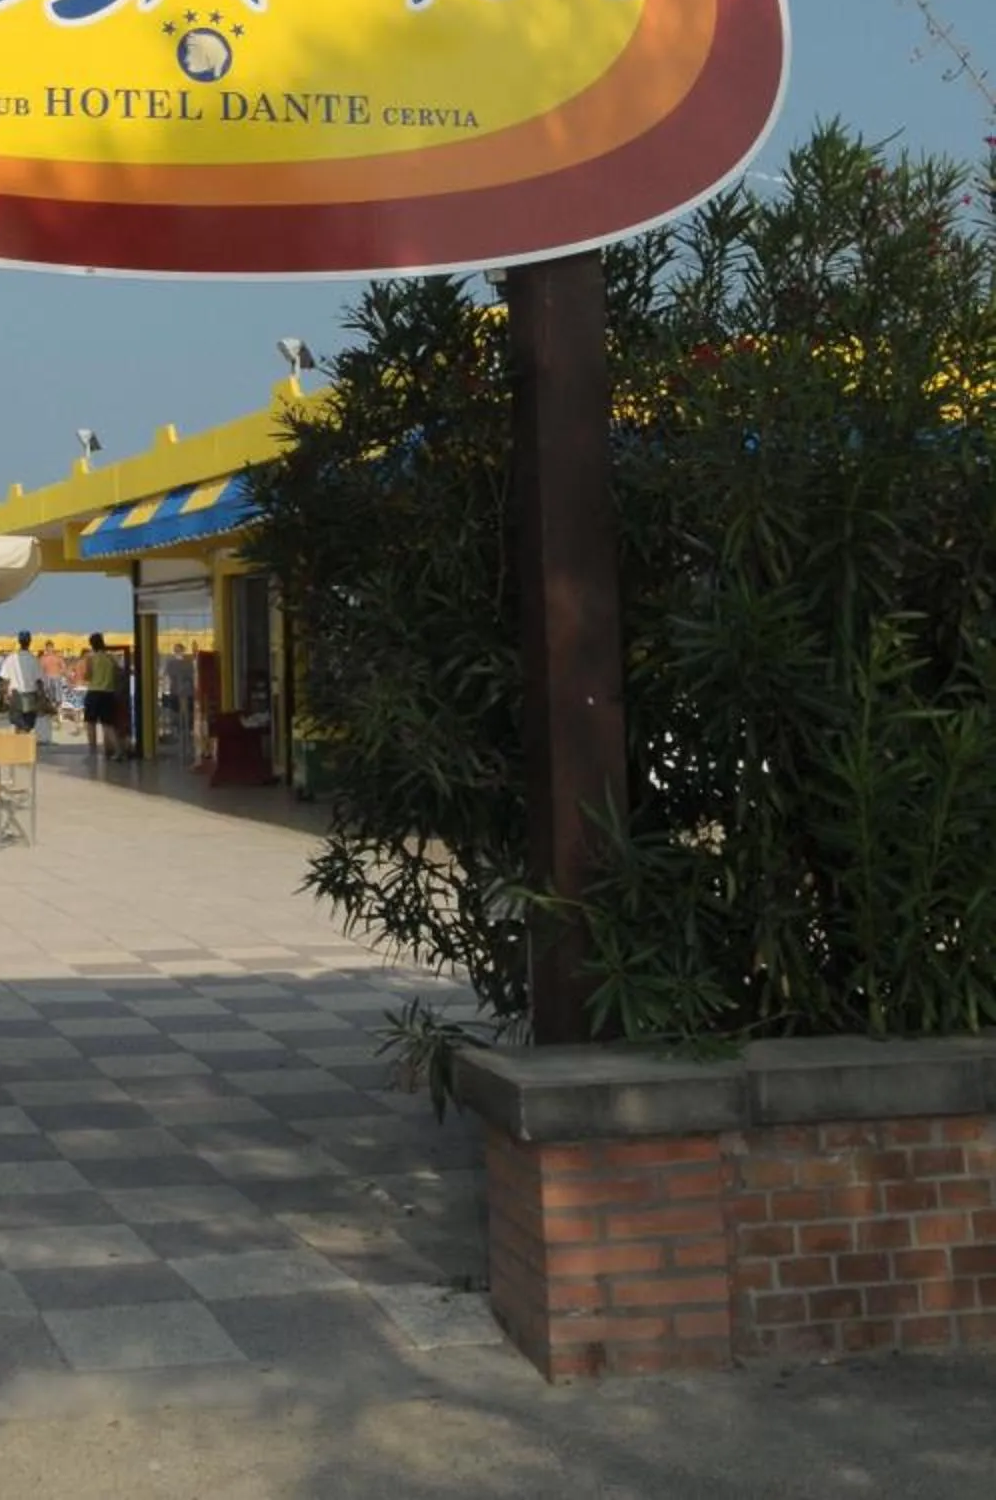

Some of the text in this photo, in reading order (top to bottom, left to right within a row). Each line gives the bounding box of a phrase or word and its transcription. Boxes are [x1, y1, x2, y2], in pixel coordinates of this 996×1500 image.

[44, 86, 203, 121] HOTEL
[219, 90, 370, 125] DANTE
[383, 106, 479, 128] CERVIA
